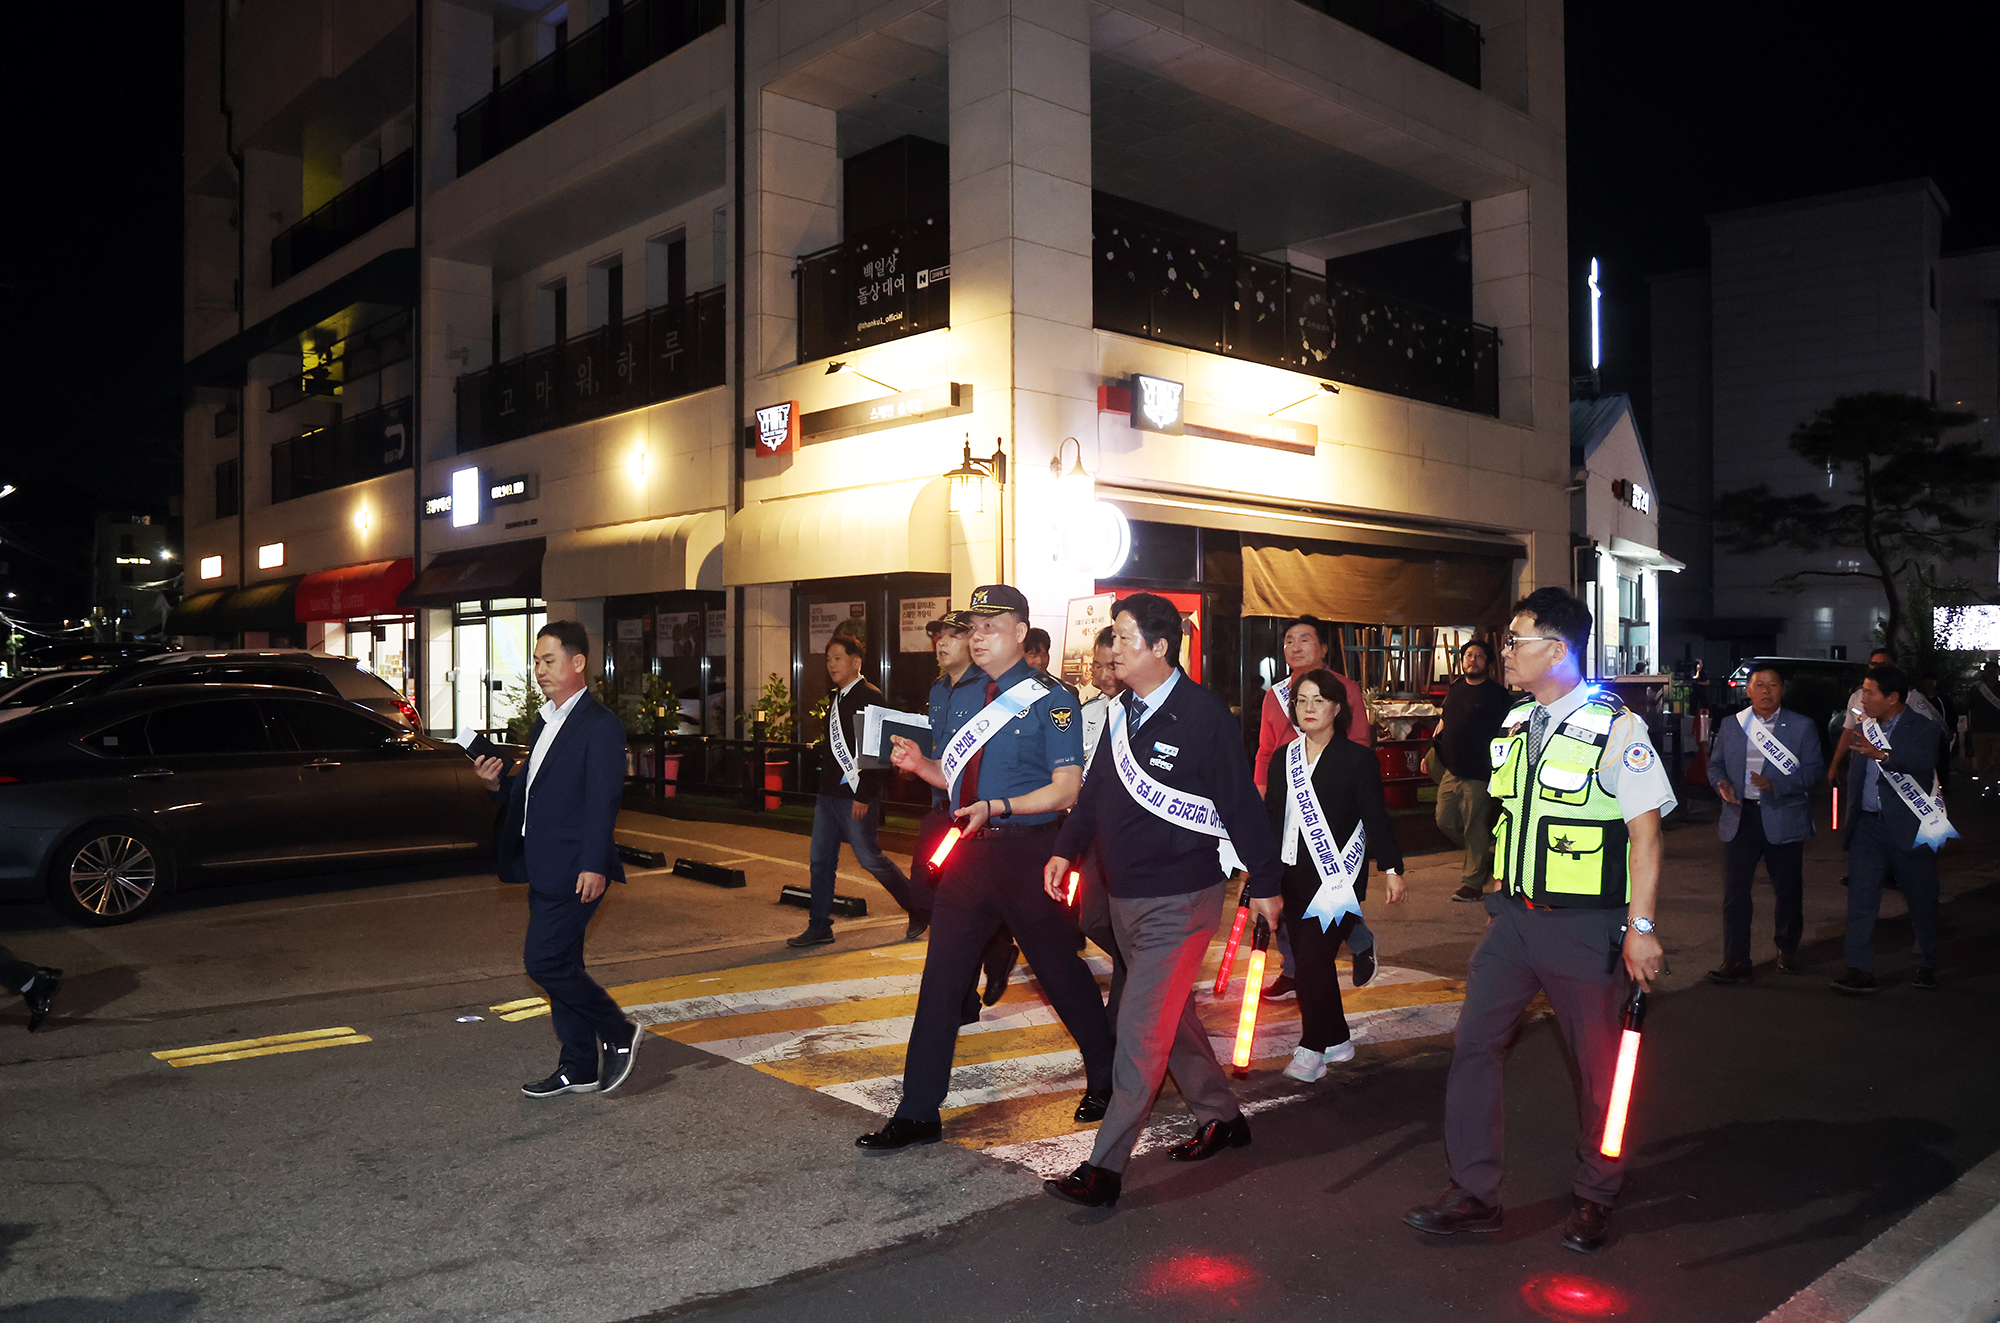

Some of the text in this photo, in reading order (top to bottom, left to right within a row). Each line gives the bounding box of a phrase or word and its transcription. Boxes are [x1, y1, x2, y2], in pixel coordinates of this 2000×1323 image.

[863, 253, 897, 279] 백일상
[953, 730, 977, 758] 범죄
[1119, 753, 1137, 786] 범죄
[1136, 779, 1166, 808] 없는
[1167, 797, 1209, 825] 안전한
[1290, 743, 1341, 877] 범죄 없는 안전한 우리동네
